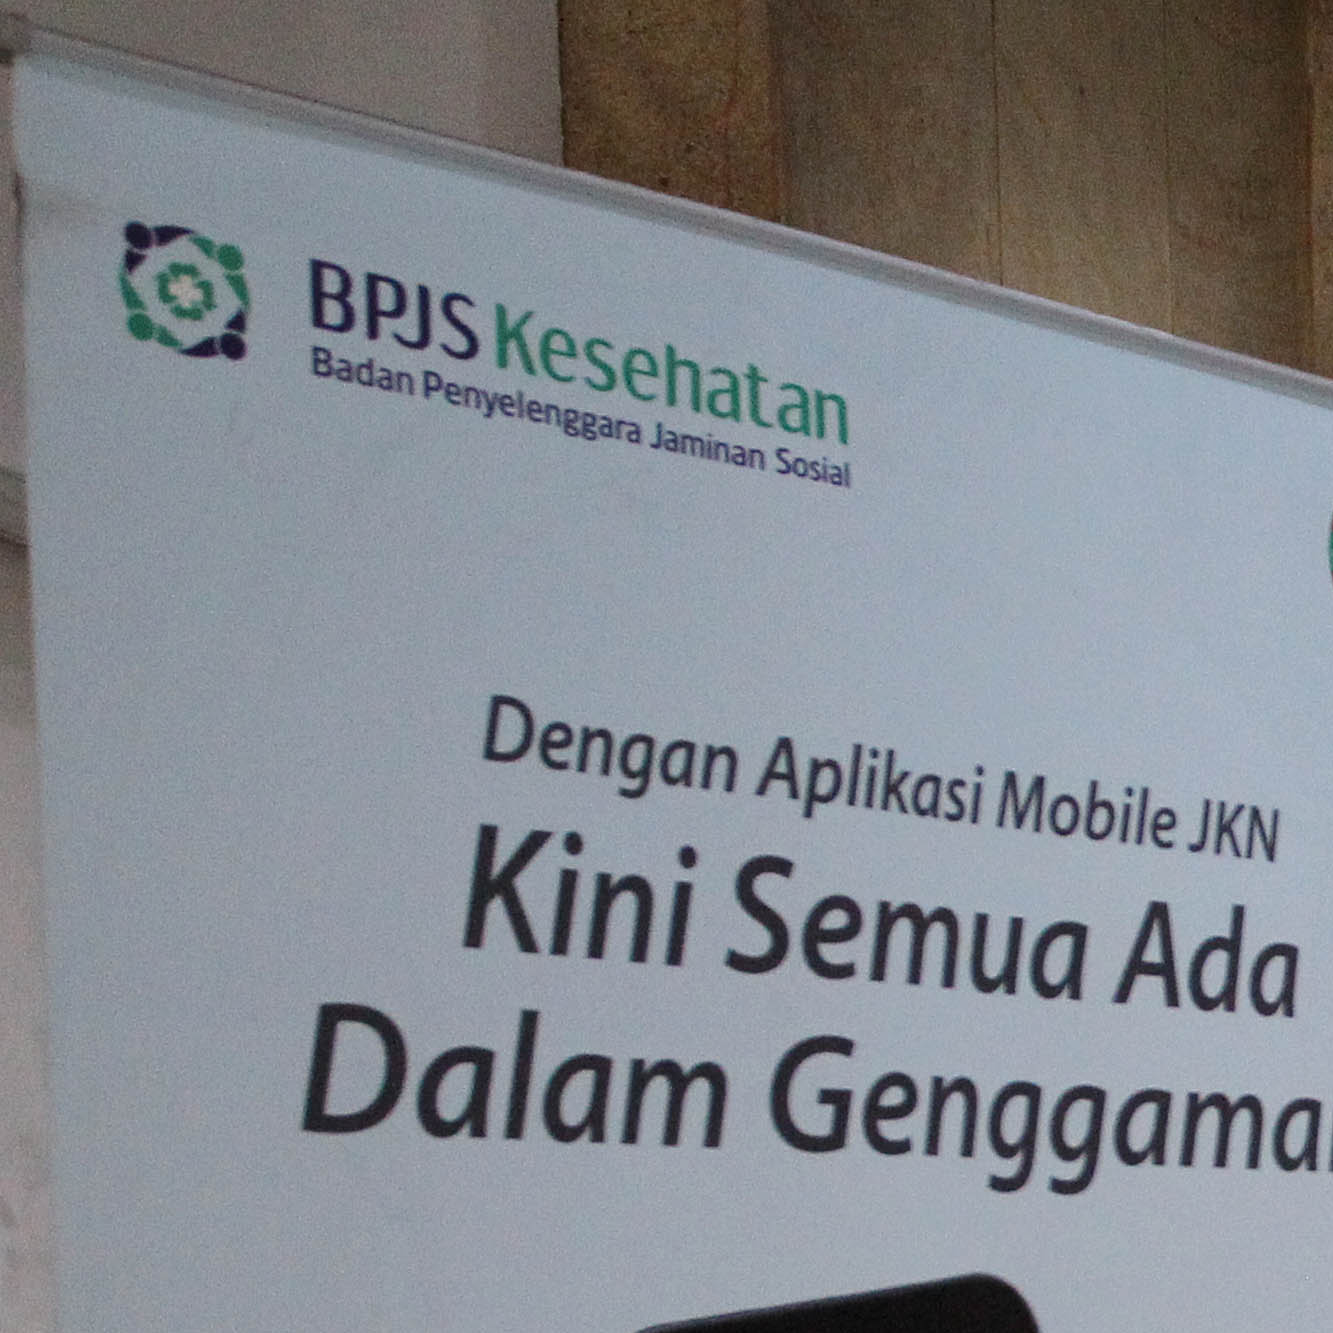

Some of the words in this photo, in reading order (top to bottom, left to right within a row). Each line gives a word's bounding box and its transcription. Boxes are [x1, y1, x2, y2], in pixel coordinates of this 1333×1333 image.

[308, 257, 480, 361] BPJS
[495, 303, 849, 446] Kesehatan
[311, 346, 416, 397] Badan
[422, 369, 642, 444] Penyelenggara
[650, 421, 766, 471] Jaminan
[775, 447, 851, 488] Sosial
[481, 692, 739, 799] Dengan
[755, 735, 985, 826] Aplikasi
[995, 768, 1180, 849] Mobile
[1187, 799, 1281, 864] JKN
[461, 822, 699, 969] Kini
[724, 853, 1090, 1001] Semua
[1113, 898, 1301, 1019] Ada
[301, 1001, 729, 1150] Dalam
